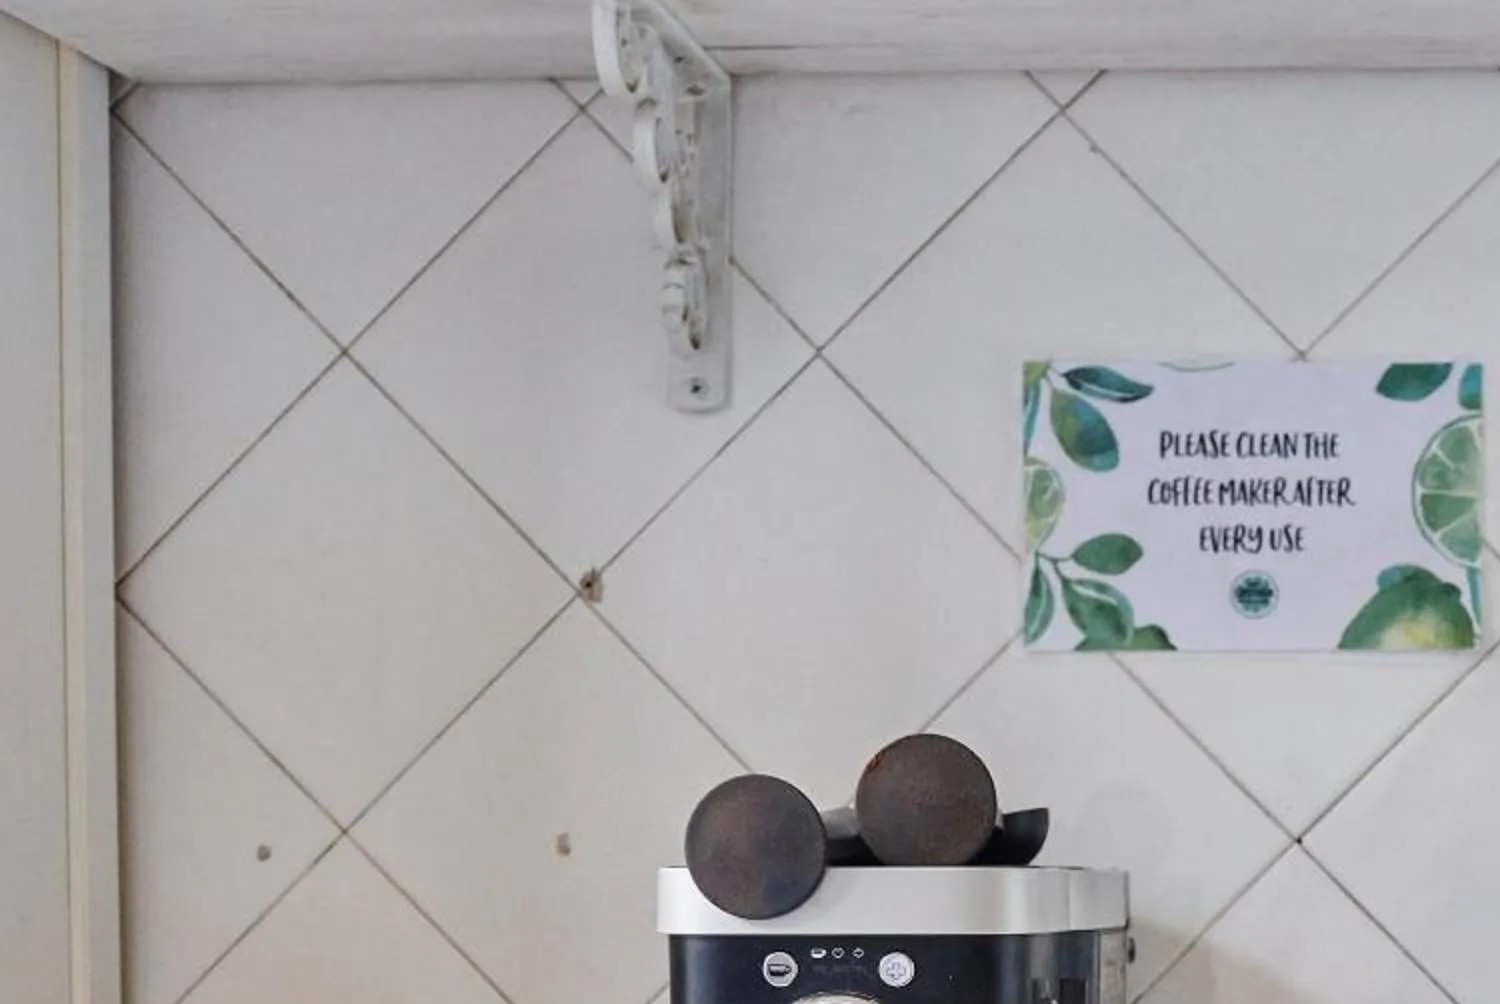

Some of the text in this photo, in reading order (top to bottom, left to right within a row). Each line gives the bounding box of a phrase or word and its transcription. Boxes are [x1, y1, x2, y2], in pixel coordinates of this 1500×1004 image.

[1159, 429, 1341, 460] PLEASE CLEAN THE
[1147, 476, 1356, 507] COFFEE MAKER AFTER
[1199, 523, 1304, 554] EVERY USE
